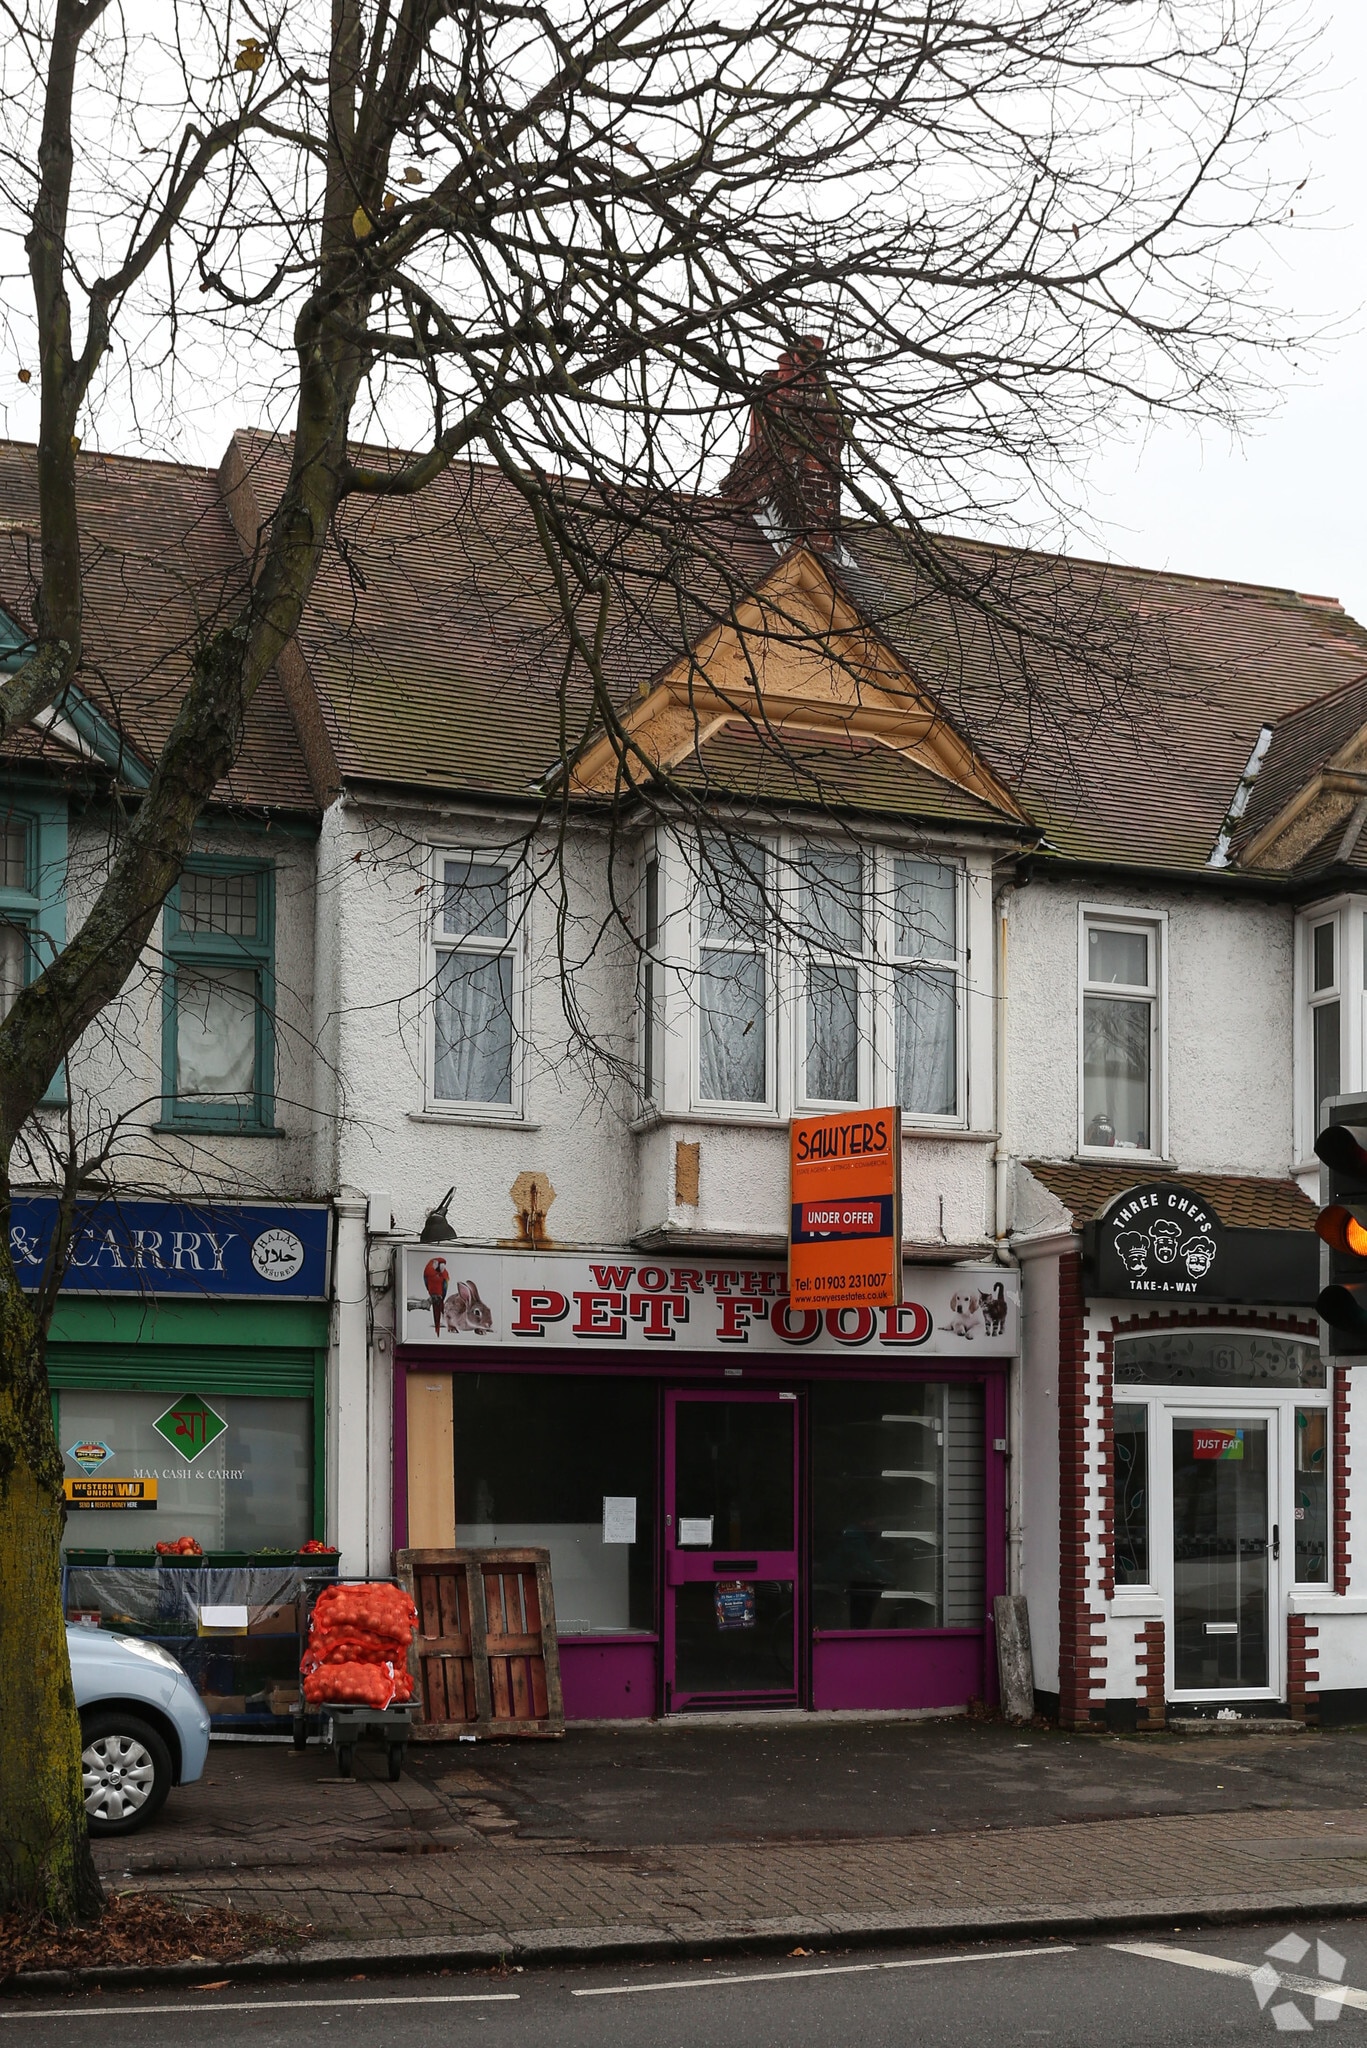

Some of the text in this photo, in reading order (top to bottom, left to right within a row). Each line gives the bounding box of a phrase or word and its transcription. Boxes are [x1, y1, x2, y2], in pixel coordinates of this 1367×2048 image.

[796, 1121, 888, 1160] SAWYERS
[808, 1211, 874, 1224] UNDER OFFER
[1113, 1193, 1212, 1233] THREE CHEFS
[10, 1226, 239, 1271] & CARRY
[258, 1231, 298, 1251] HALAL
[259, 1248, 297, 1265] حلال
[260, 1265, 295, 1278] ASSURED
[589, 1264, 790, 1296] WORTHI
[795, 1273, 887, 1291] Tel: 01903 231007
[1130, 1280, 1198, 1293] TAKE-A-WAY
[795, 1290, 888, 1304] www.sawyersestates.co.uk
[511, 1288, 933, 1347] PET FOOD
[1208, 1349, 1237, 1371] 161
[1197, 1439, 1240, 1450] JUST EAT
[133, 1469, 245, 1480] MAA CASH & CARRY
[115, 1483, 141, 1497] WU
